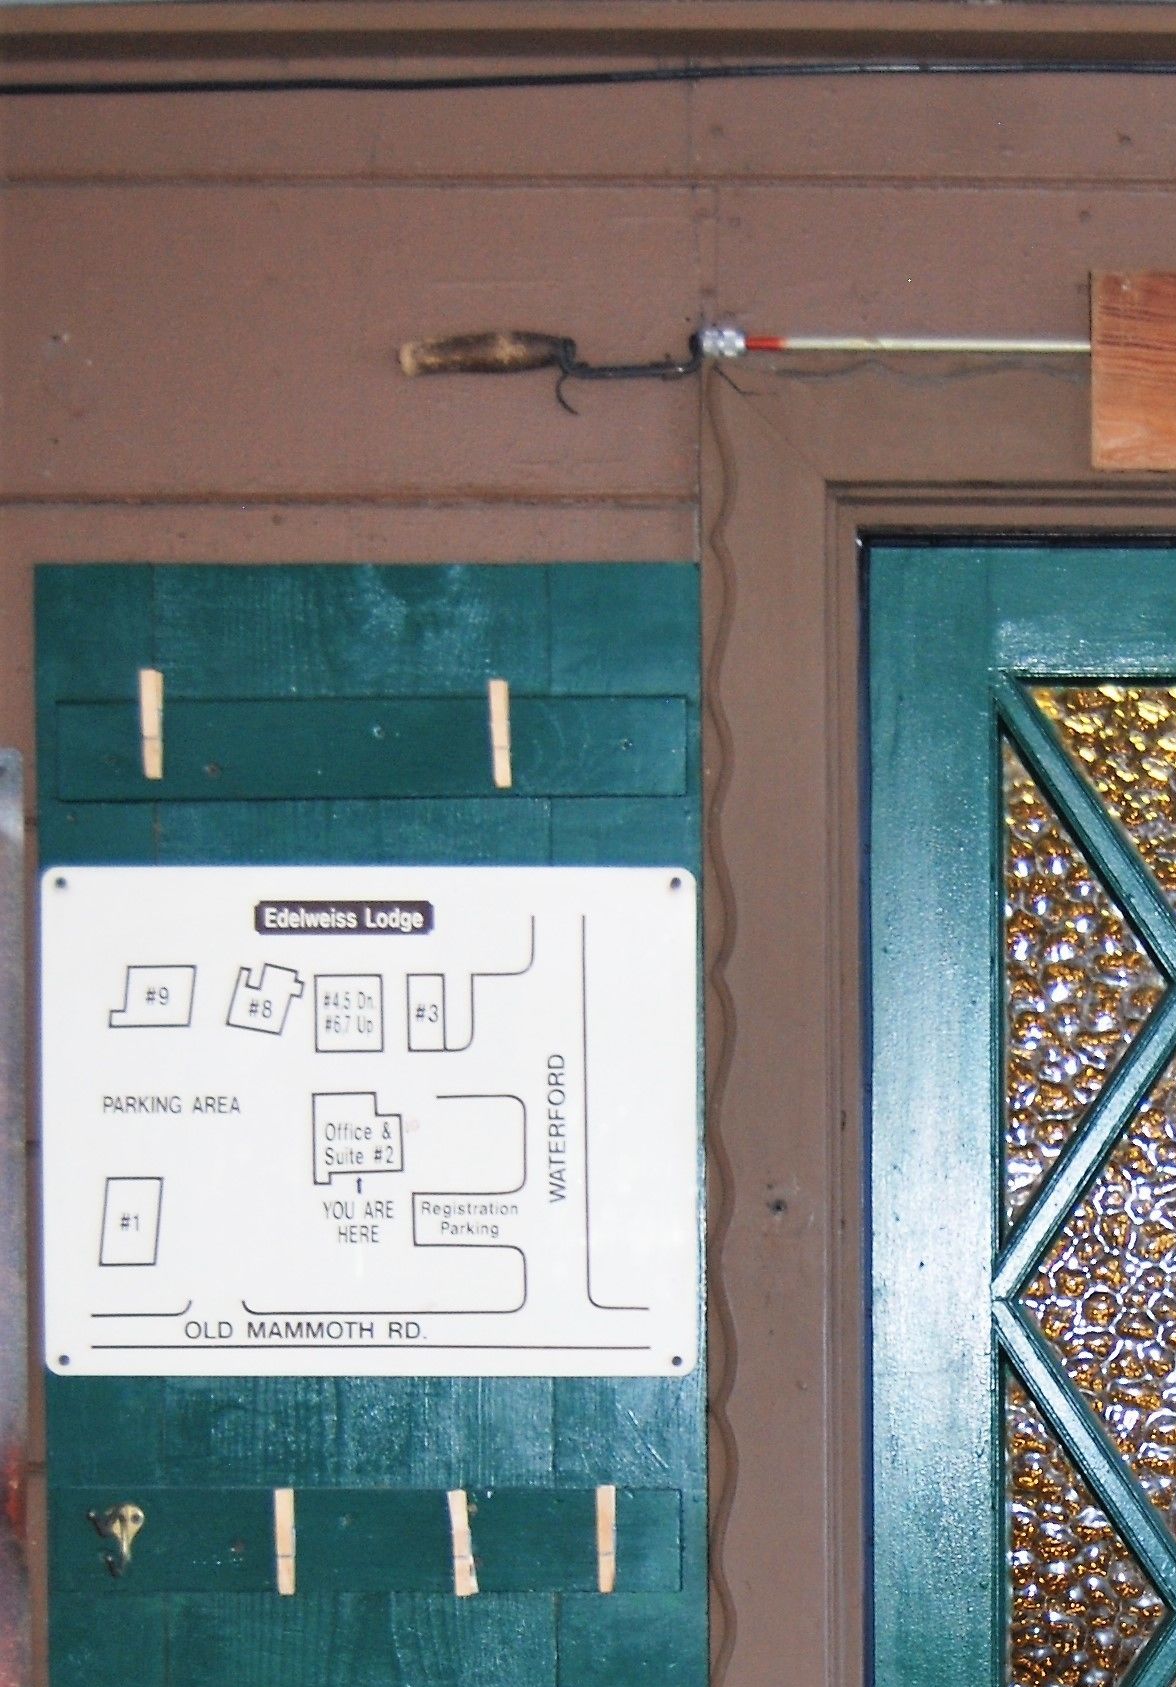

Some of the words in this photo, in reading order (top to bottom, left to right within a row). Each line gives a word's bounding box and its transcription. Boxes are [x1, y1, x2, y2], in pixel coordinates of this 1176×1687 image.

[264, 907, 358, 929] Edelweiss
[364, 907, 425, 933] Lodge
[146, 986, 170, 1006] #9
[248, 999, 273, 1019] #8
[415, 1003, 439, 1023] #3
[103, 1095, 182, 1114] PARKING
[192, 1095, 241, 1114] AREA
[325, 1122, 372, 1141] Office
[382, 1121, 392, 1140] &
[547, 1053, 566, 1204] WATERFORD
[325, 1147, 364, 1166] Suite
[374, 1145, 394, 1164] #2
[323, 1200, 355, 1219] YOU
[364, 1200, 394, 1219] ARE
[421, 1201, 519, 1218] Registration
[120, 1213, 140, 1232] #1
[441, 1221, 500, 1238] Parking
[338, 1225, 379, 1243] HERE
[184, 1320, 233, 1340] OLD
[247, 1320, 375, 1340] MAMMOTH
[388, 1320, 428, 1340] RD.
